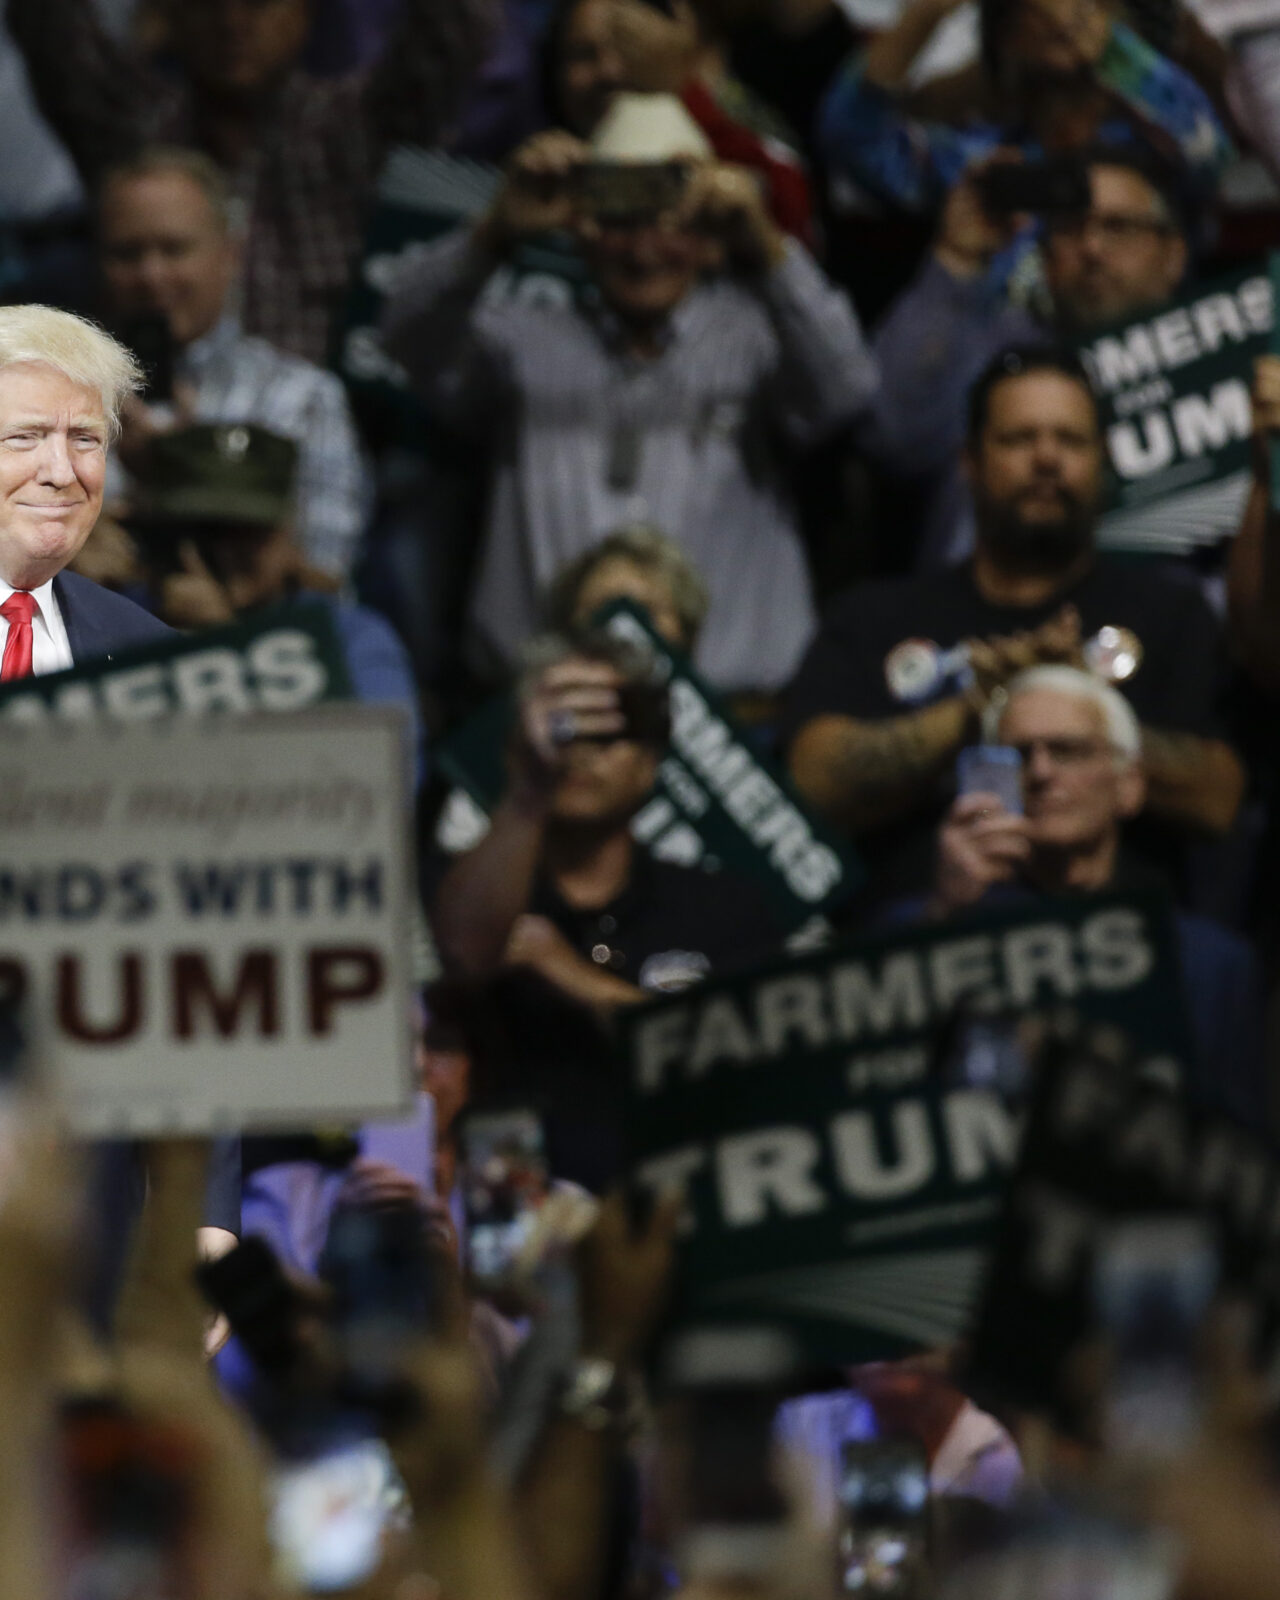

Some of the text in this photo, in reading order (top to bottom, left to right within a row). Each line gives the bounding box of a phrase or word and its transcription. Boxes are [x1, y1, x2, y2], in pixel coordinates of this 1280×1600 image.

[1079, 275, 1277, 392] MERS
[175, 855, 385, 918] WITH
[630, 906, 1157, 1096] FARMERS
[635, 1088, 1025, 1236] TRUM
